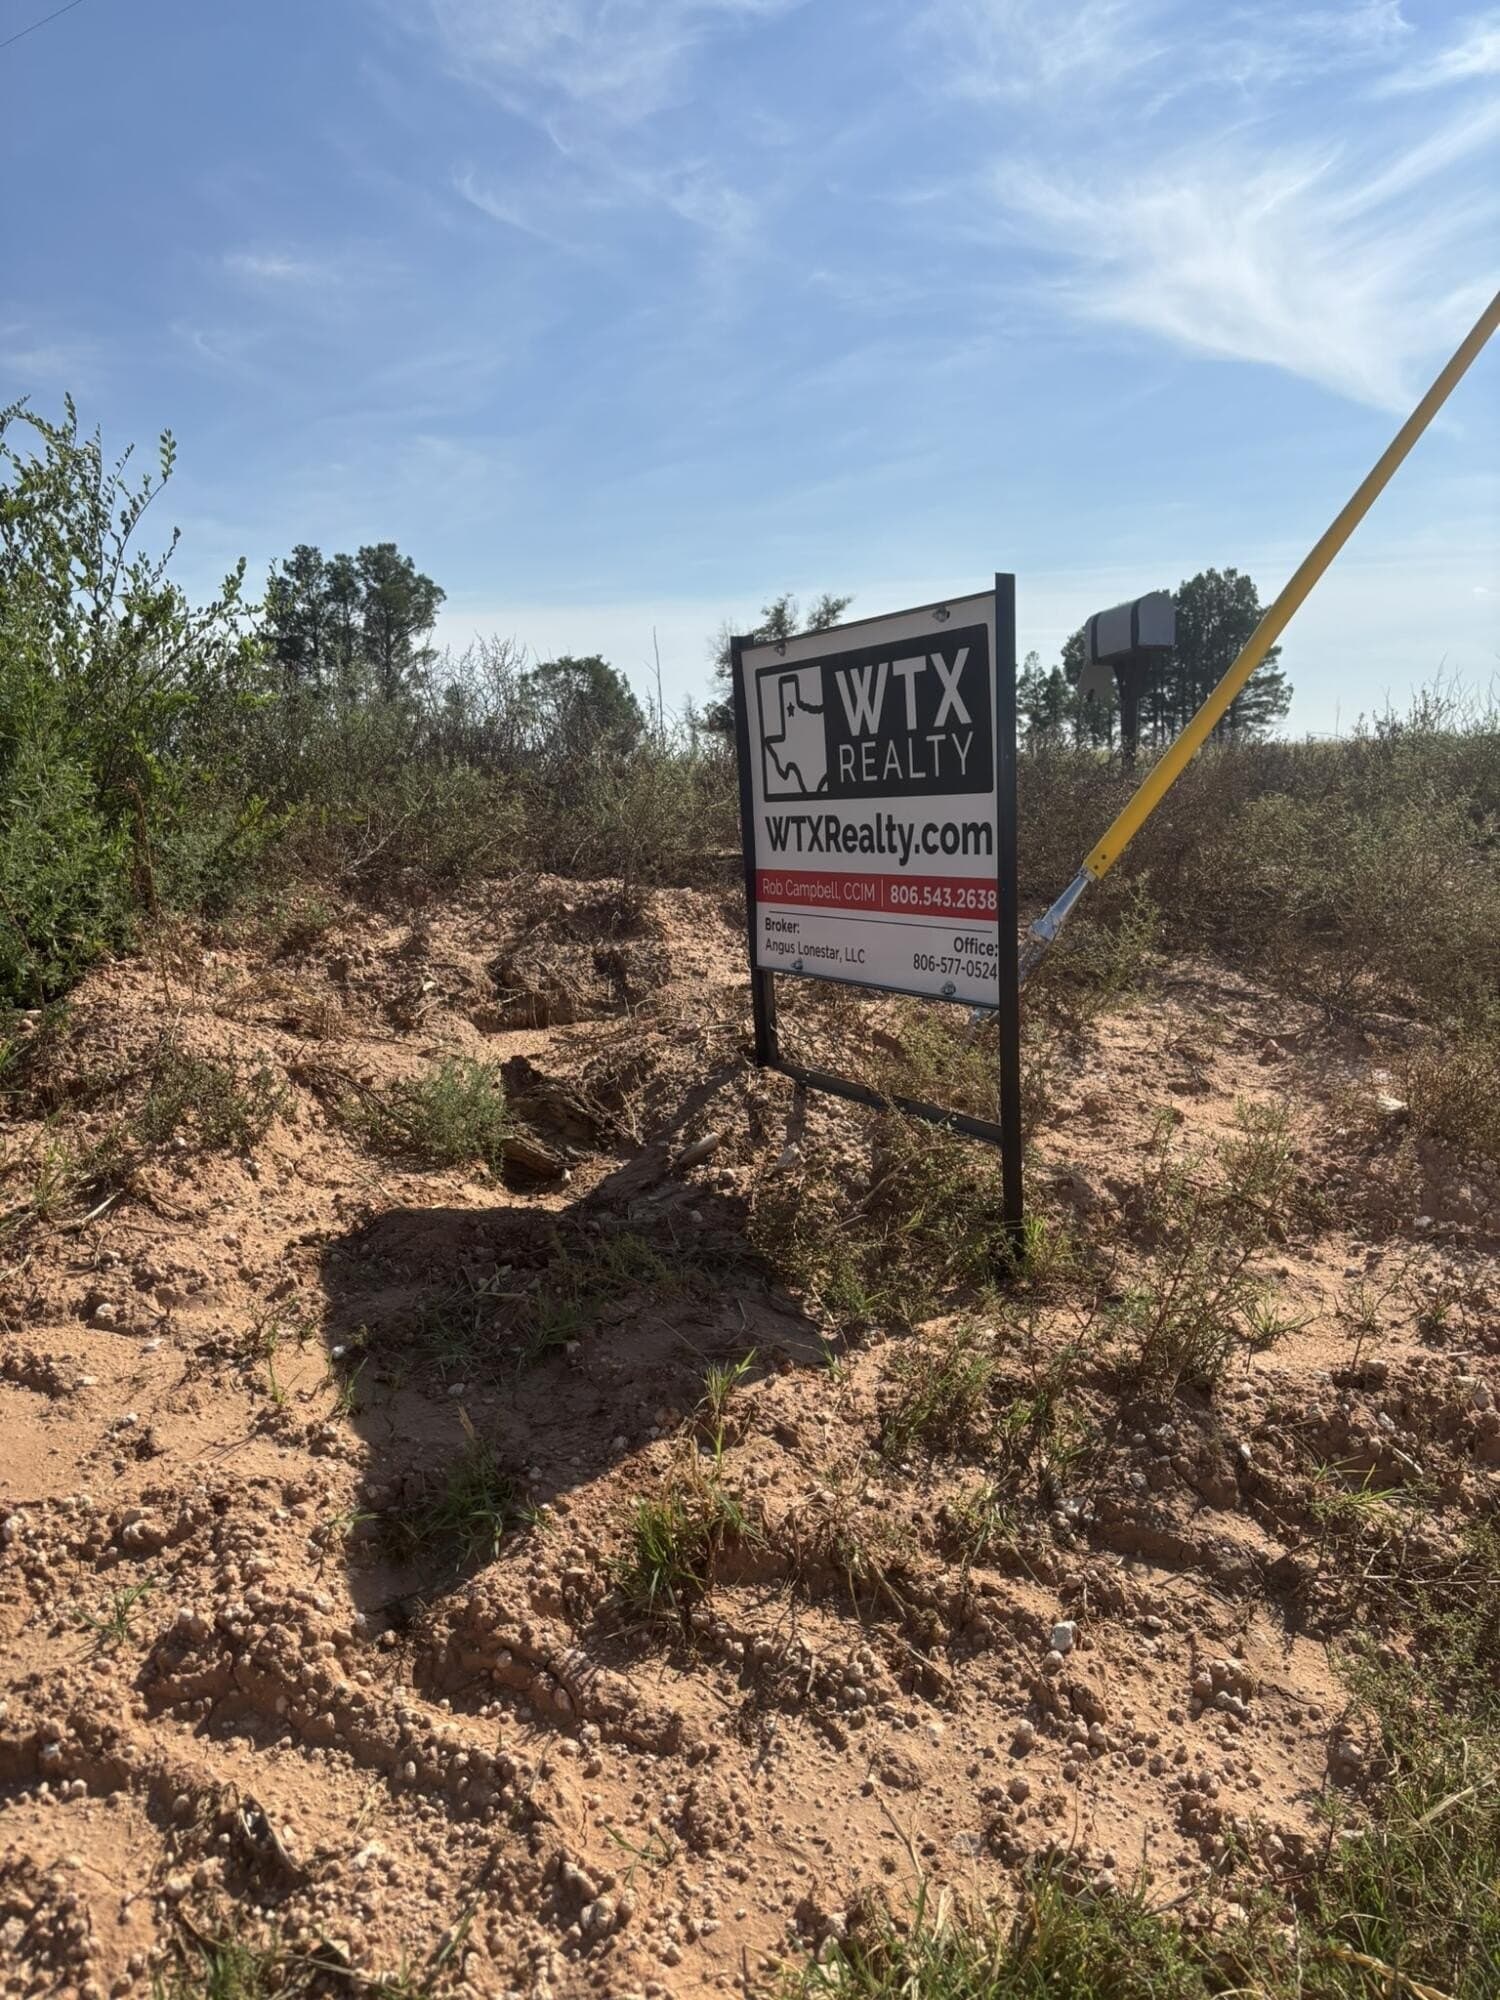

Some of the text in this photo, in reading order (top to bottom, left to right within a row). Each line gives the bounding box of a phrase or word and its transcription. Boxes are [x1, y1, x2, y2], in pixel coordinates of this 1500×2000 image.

[835, 648, 972, 736] WTX
[838, 731, 974, 783] REALTY
[765, 812, 993, 866] WTXRealty.com
[762, 878, 783, 896] Rob
[843, 882, 875, 901] CCIM
[890, 885, 997, 910] 806.543.2638
[764, 917, 800, 934] Broker:
[765, 938, 865, 963] Angus Lonestar, LLC
[953, 936, 998, 957] Office:
[913, 953, 998, 980] 806-577-0524
